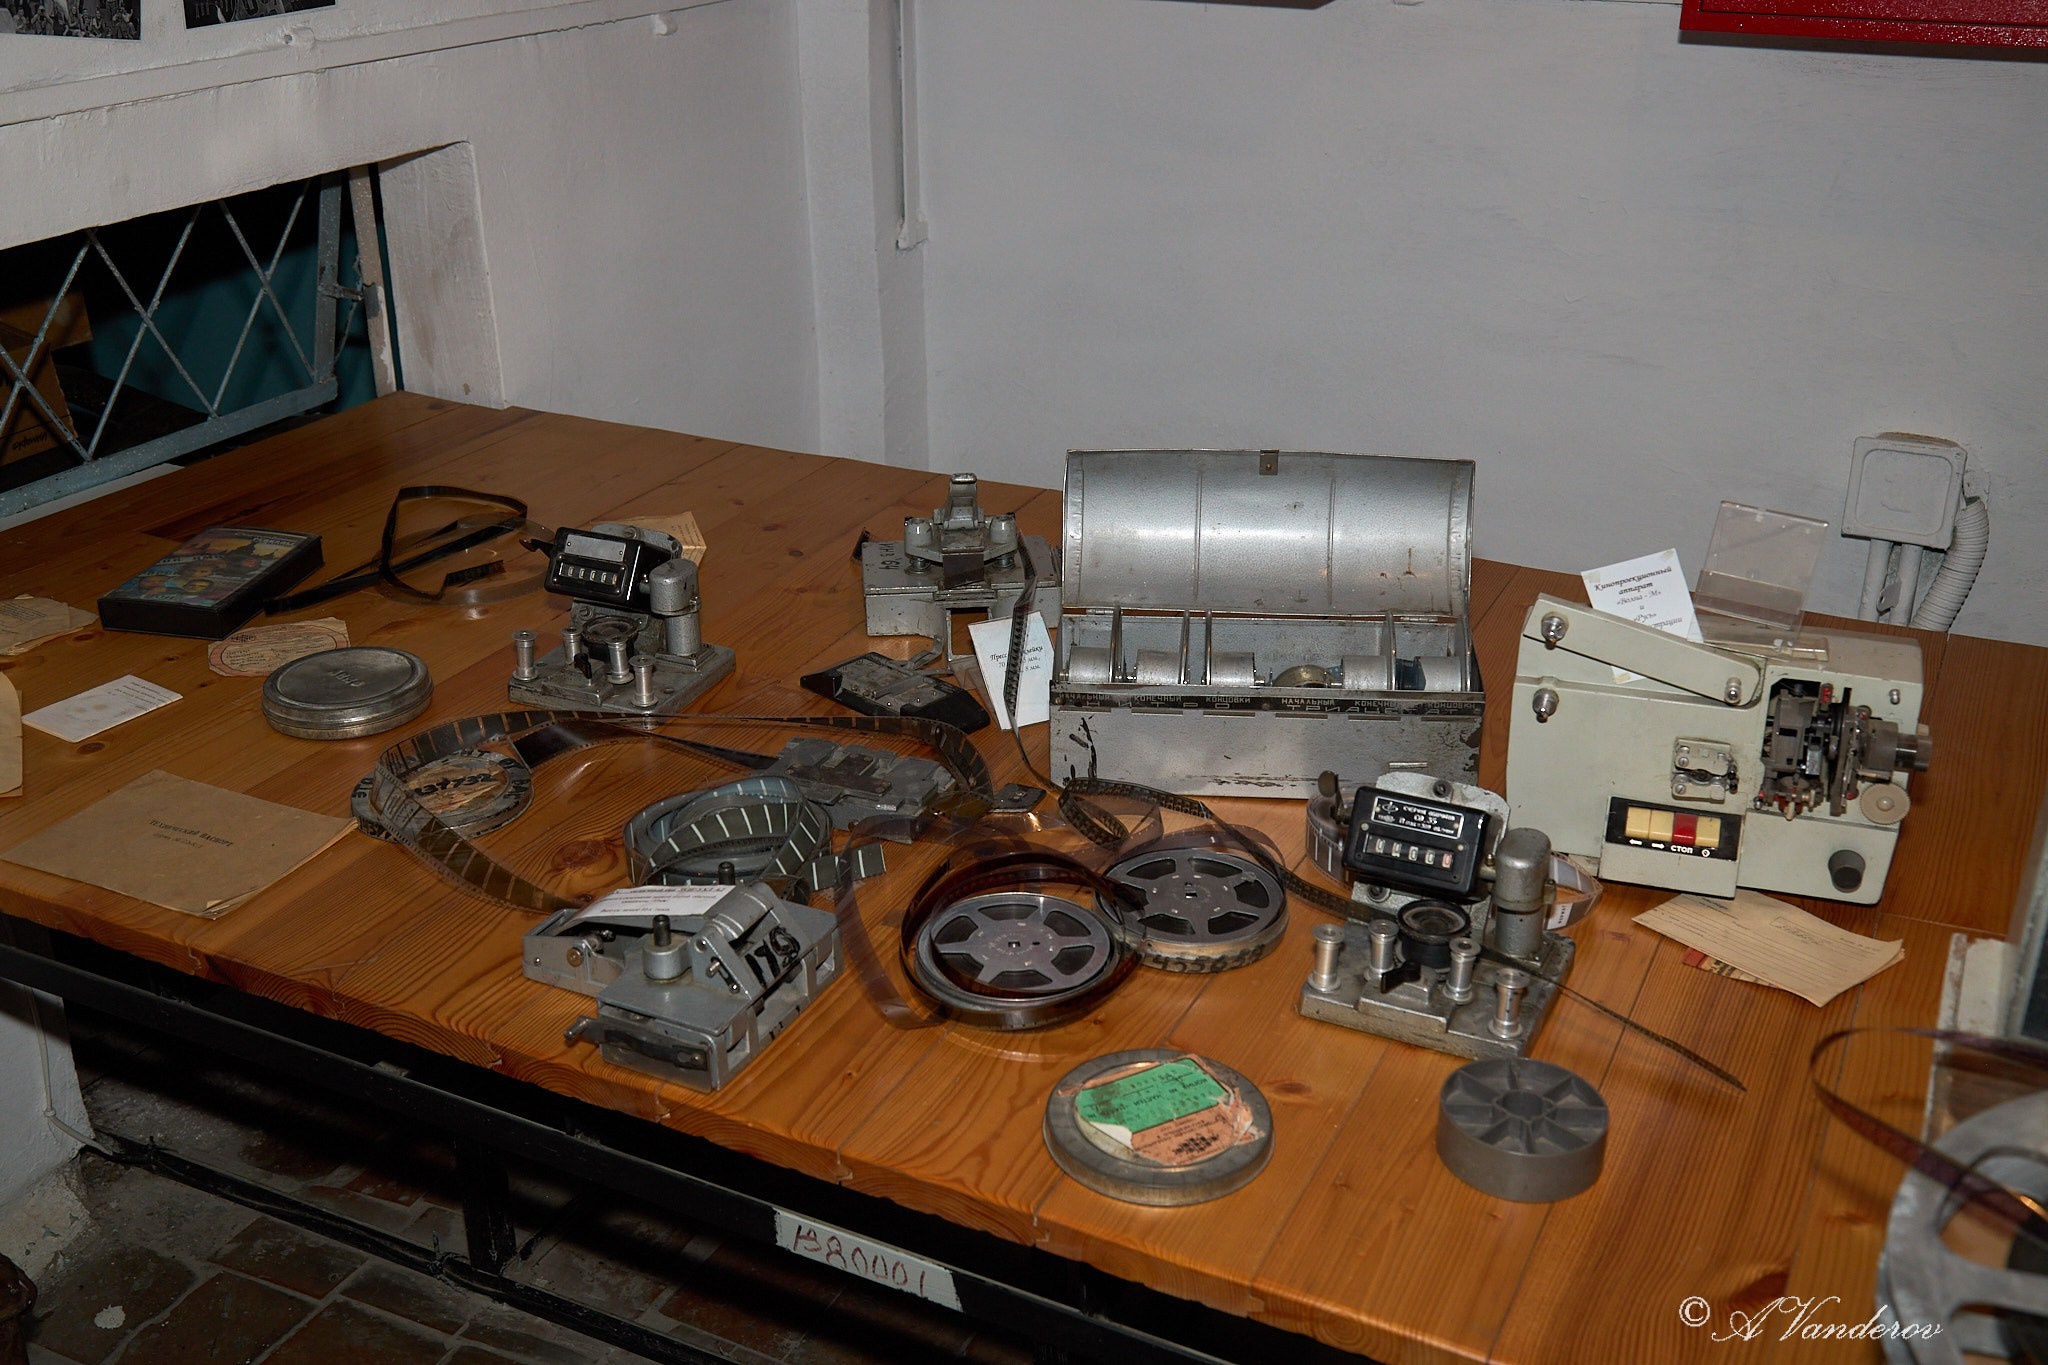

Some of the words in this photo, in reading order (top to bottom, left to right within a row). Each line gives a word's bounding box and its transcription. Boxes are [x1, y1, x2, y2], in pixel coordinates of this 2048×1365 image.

[1594, 566, 1672, 591] Кинопроекционный
[1619, 582, 1653, 595] аппарат
[1205, 696, 1251, 704] КОНЦОВКИ
[1281, 697, 1335, 706] НАЧАЛЬНЫЙ
[199, 832, 234, 847] ПАСПОРТ
[1670, 845, 1693, 854] СТОП
